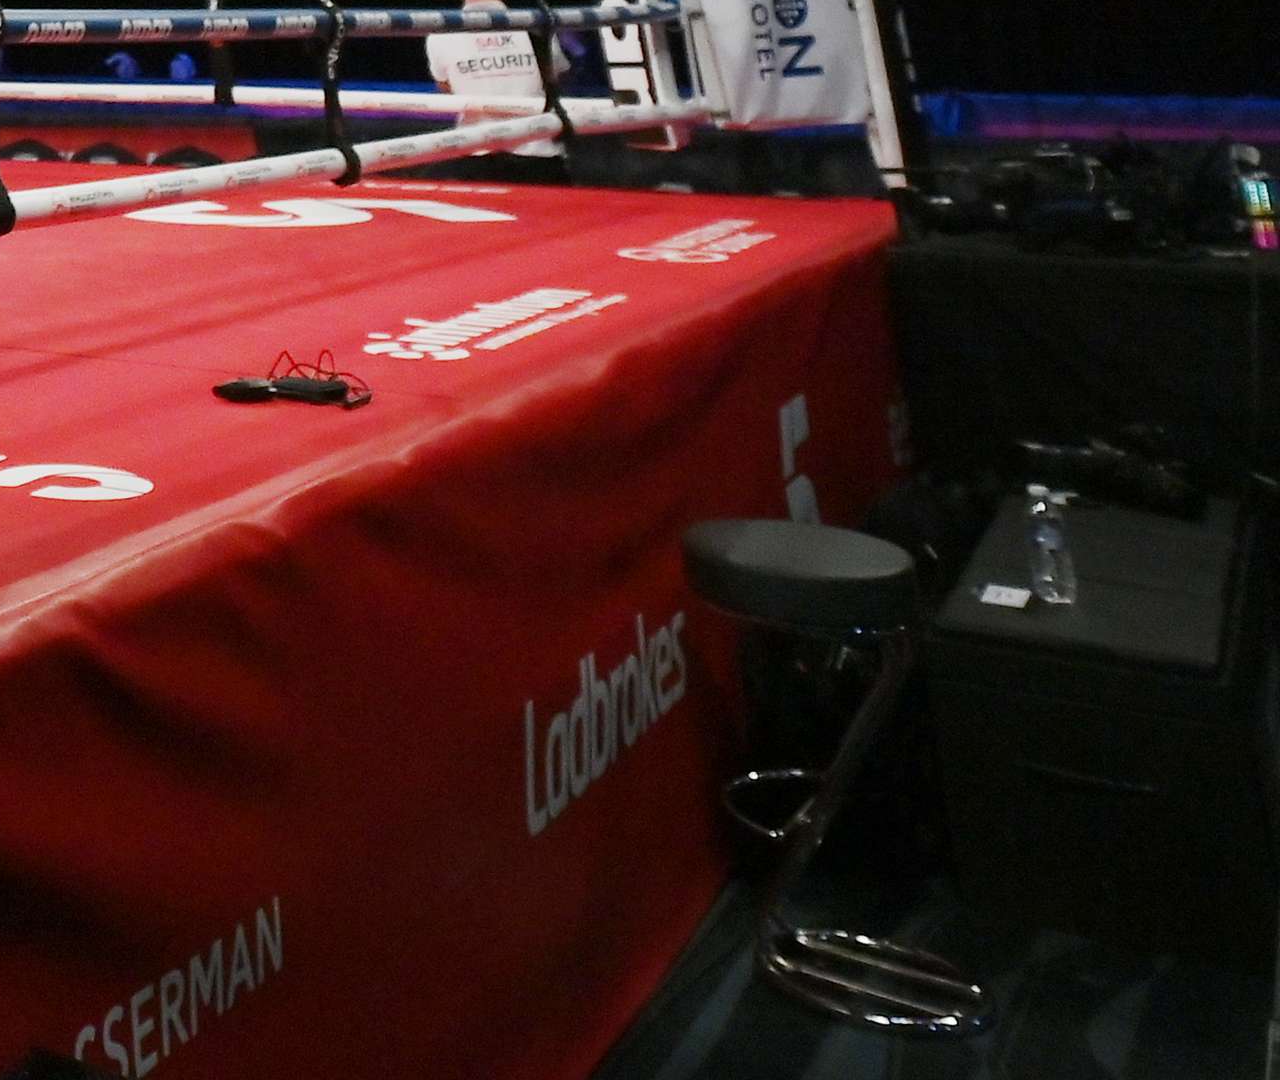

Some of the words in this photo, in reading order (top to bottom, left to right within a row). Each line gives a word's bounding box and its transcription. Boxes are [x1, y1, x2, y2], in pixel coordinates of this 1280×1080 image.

[456, 54, 536, 74] SECURIT
[524, 611, 687, 836] Ladbrokes
[74, 895, 284, 1080] SERMAN
